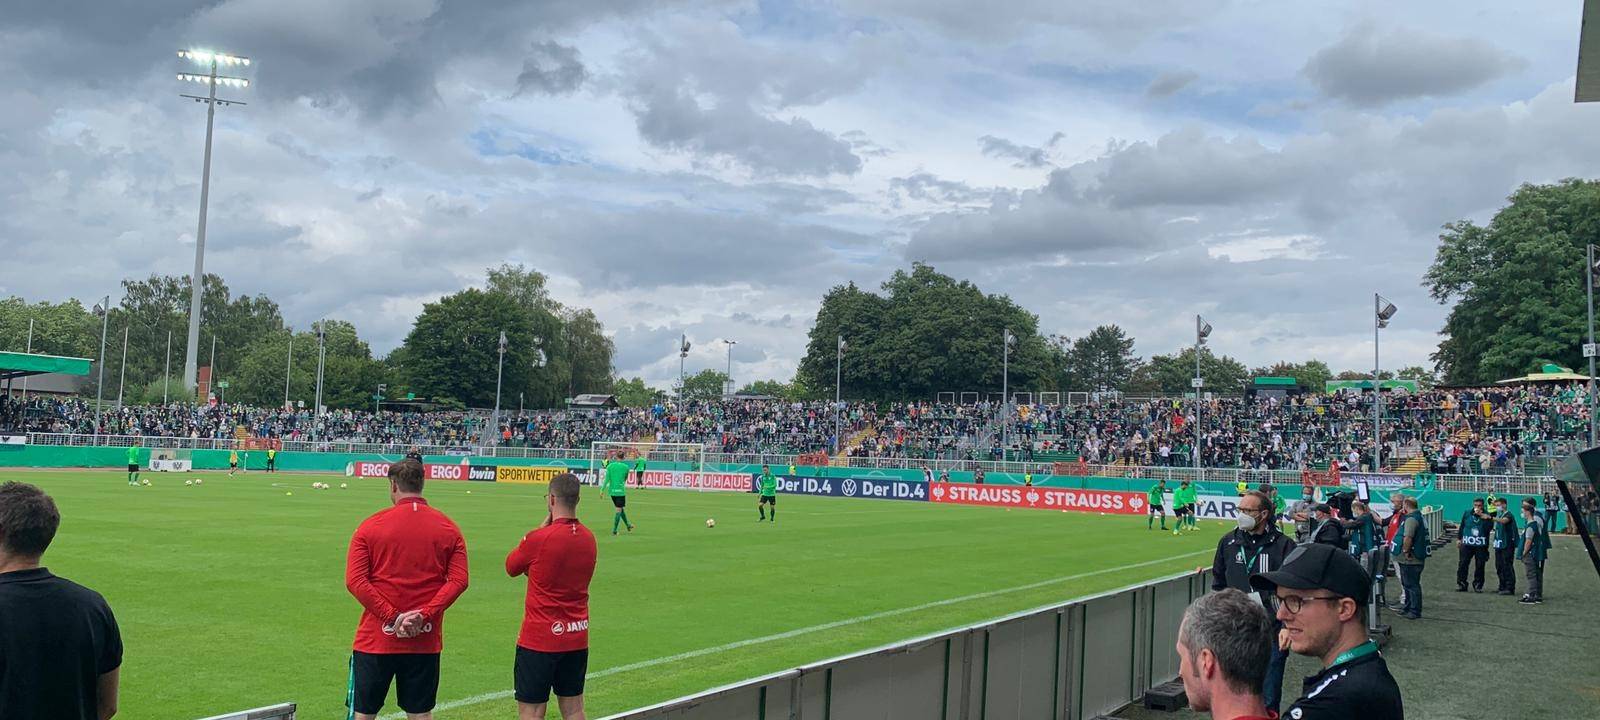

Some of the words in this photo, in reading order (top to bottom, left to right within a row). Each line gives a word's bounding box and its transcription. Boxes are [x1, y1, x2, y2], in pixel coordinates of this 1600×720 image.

[361, 463, 389, 476] ERGO
[430, 464, 461, 479] ERGO
[469, 467, 495, 480] bwin
[570, 470, 596, 483] win
[684, 475, 751, 489] BAUHAUS
[776, 478, 800, 492] Der
[802, 478, 832, 494] ID.4
[862, 481, 889, 496] Der
[892, 483, 925, 498] ID.4
[949, 486, 1021, 503] STRAUSS
[1044, 490, 1124, 510] STRAUSS
[1462, 535, 1487, 545] HOST
